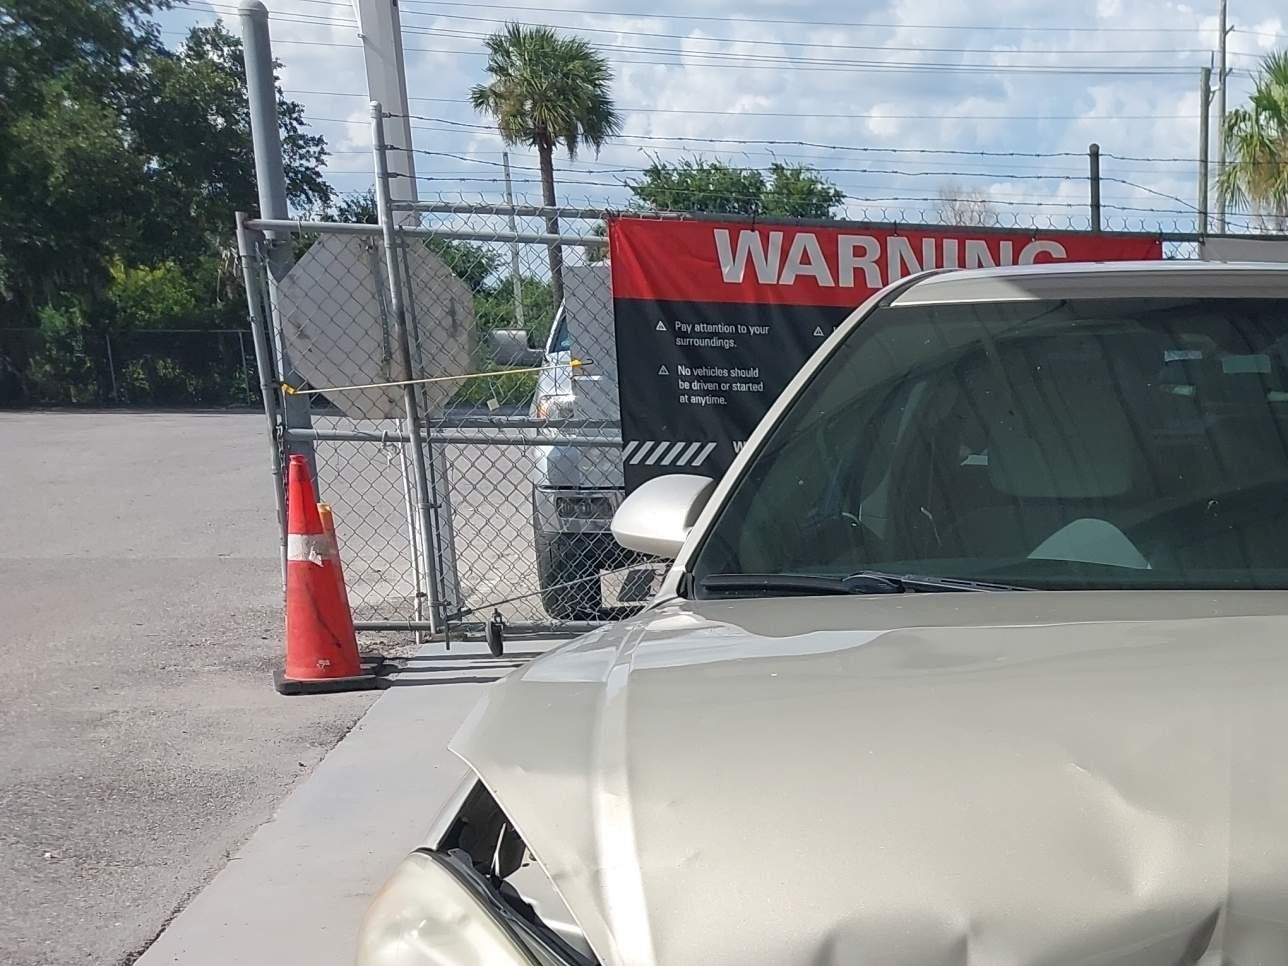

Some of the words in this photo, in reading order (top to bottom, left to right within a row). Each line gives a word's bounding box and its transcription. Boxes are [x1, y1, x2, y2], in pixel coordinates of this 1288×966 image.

[675, 321, 692, 334] Pay
[694, 322, 736, 333] attention
[738, 323, 747, 333] to
[749, 326, 770, 336] your
[675, 337, 737, 349] surroundings.
[677, 365, 691, 376] No
[693, 366, 729, 378] vehicles
[730, 367, 759, 378] should
[678, 379, 690, 390] be
[691, 380, 719, 391] driven
[721, 382, 730, 391] or
[732, 381, 764, 392] started
[679, 394, 689, 404] at
[690, 395, 727, 406] anytime.
